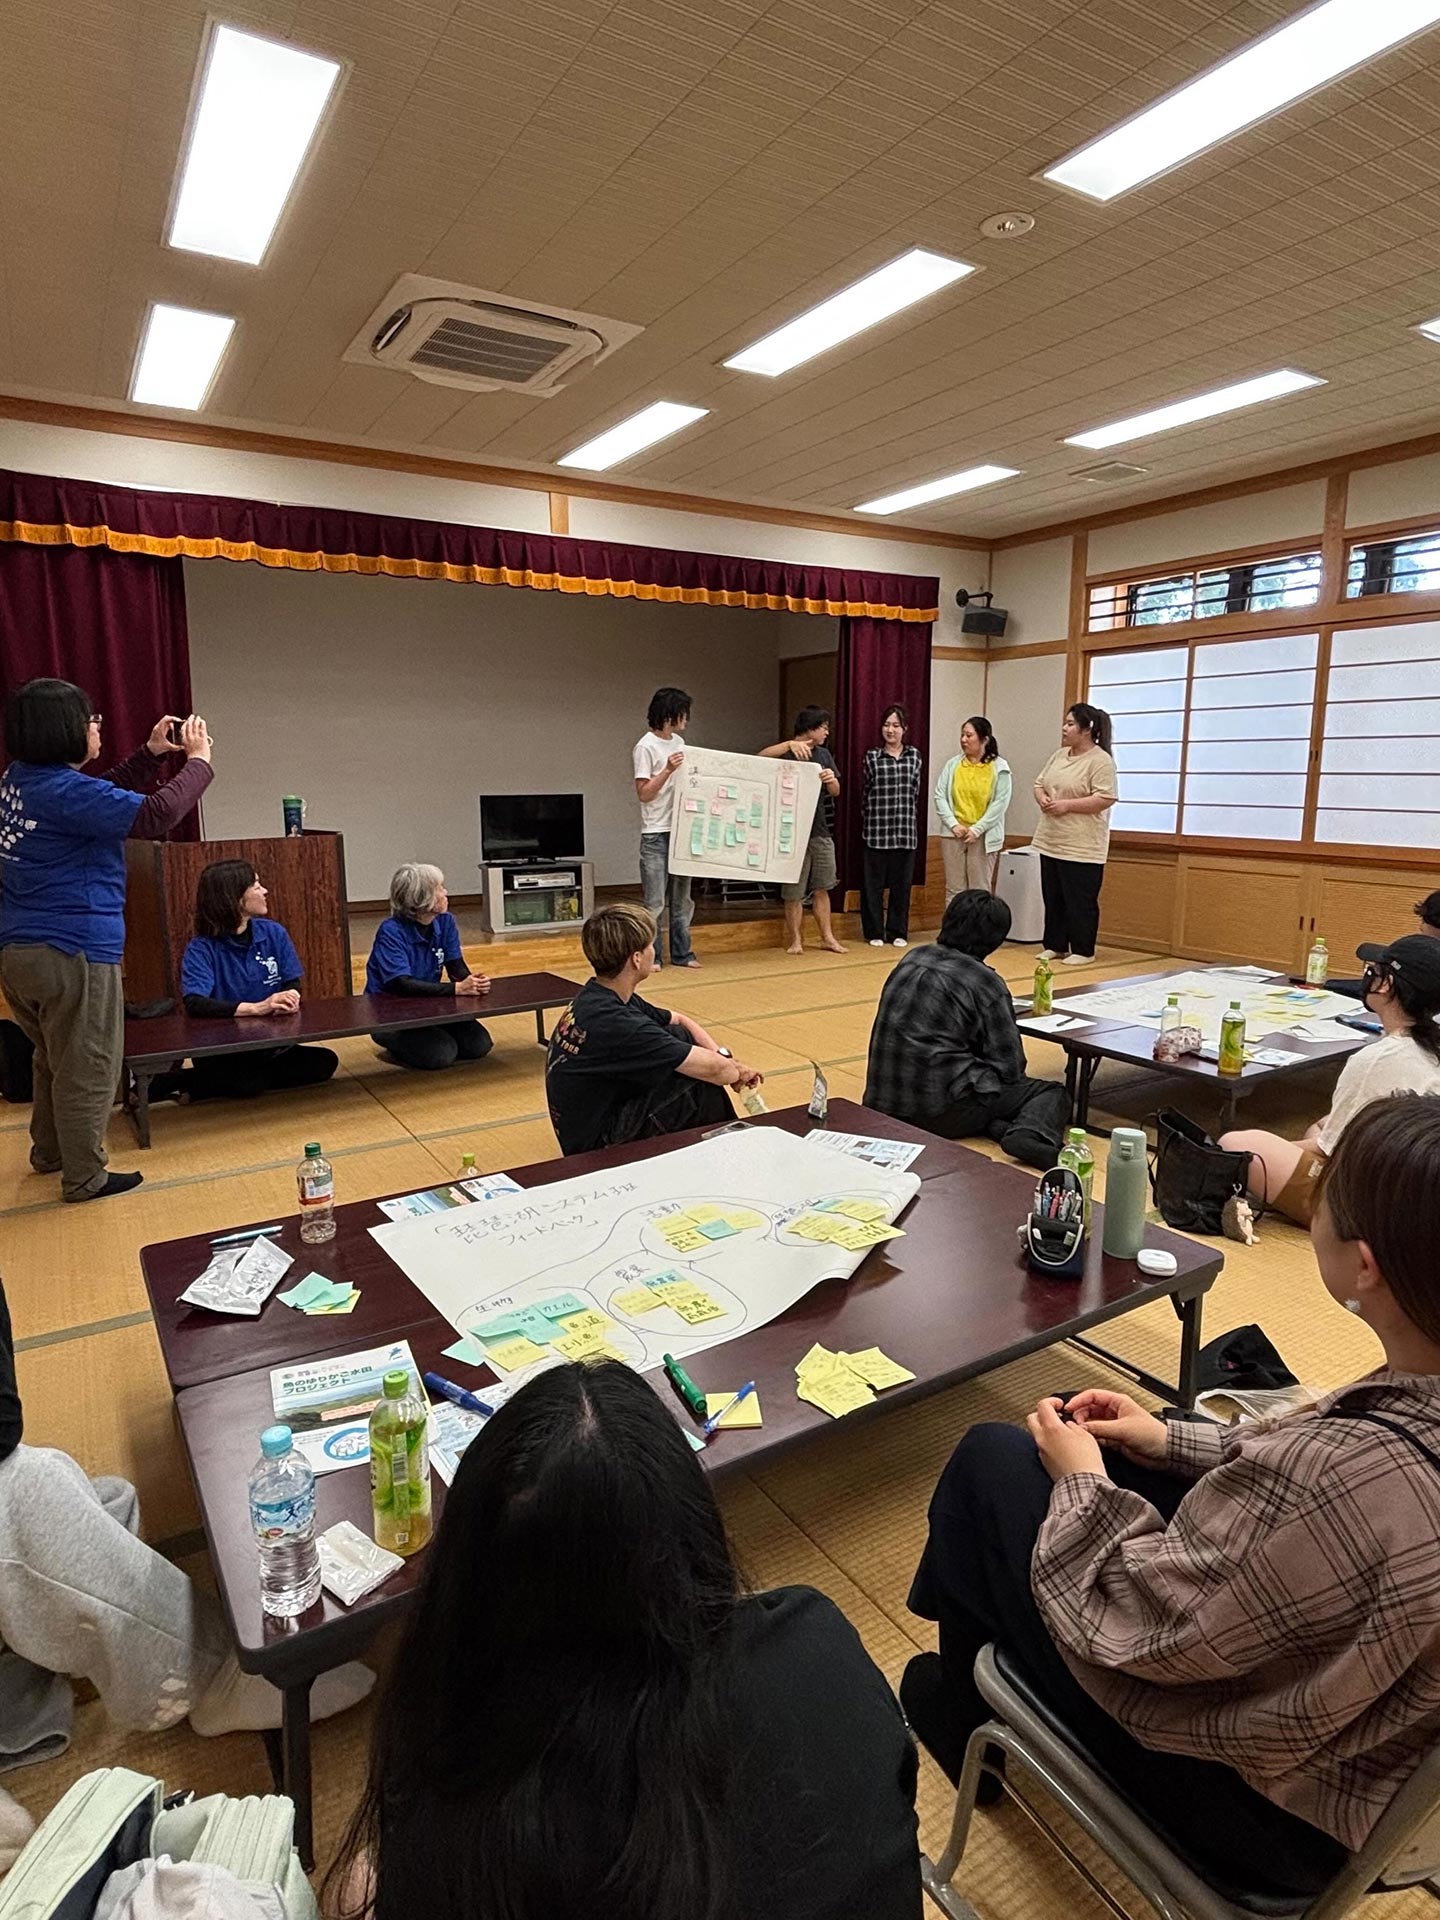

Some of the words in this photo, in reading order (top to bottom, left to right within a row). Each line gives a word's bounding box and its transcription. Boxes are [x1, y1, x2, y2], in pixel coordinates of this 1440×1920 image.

[282, 1365, 374, 1389] 魚のゆりかご水田
[284, 1377, 352, 1396] プロジェクト
